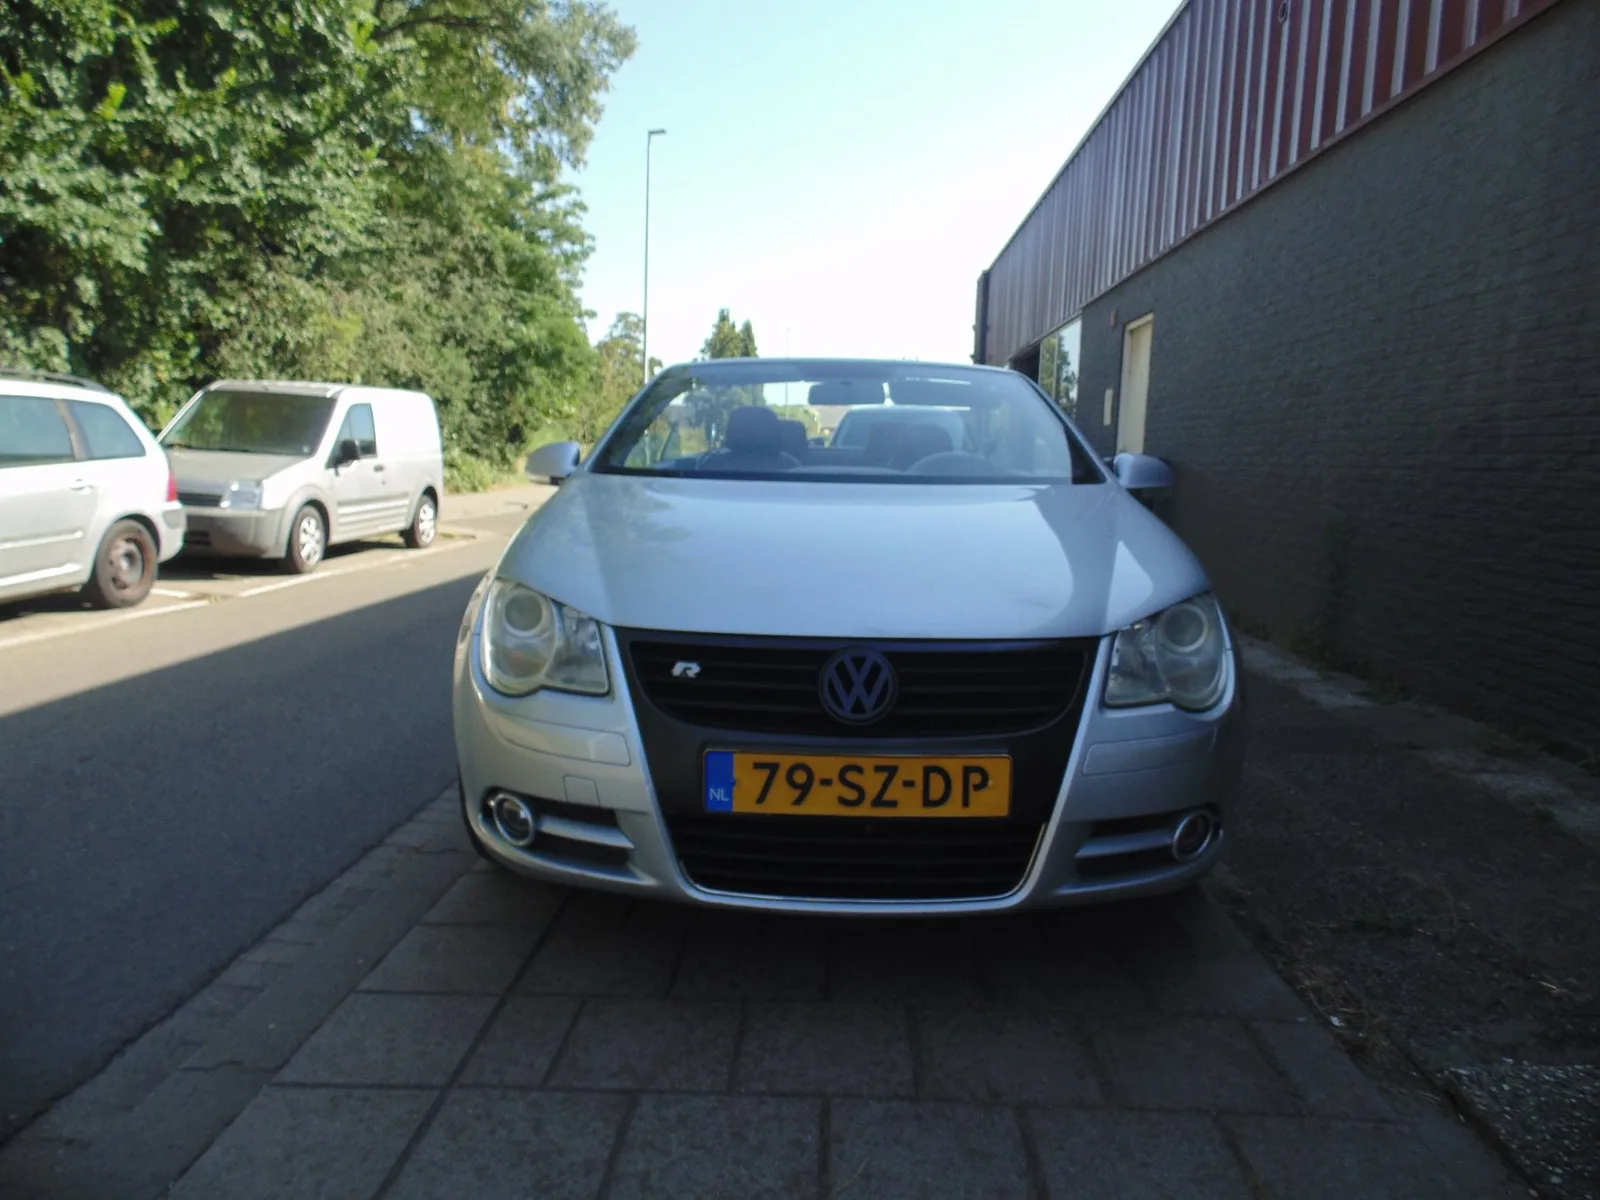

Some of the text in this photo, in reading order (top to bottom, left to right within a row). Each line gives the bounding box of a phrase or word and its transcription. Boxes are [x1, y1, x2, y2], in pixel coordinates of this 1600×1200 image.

[671, 660, 701, 678] R
[824, 650, 894, 719] VW
[709, 787, 730, 801] NL
[752, 762, 989, 808] 79-SZ-DP
